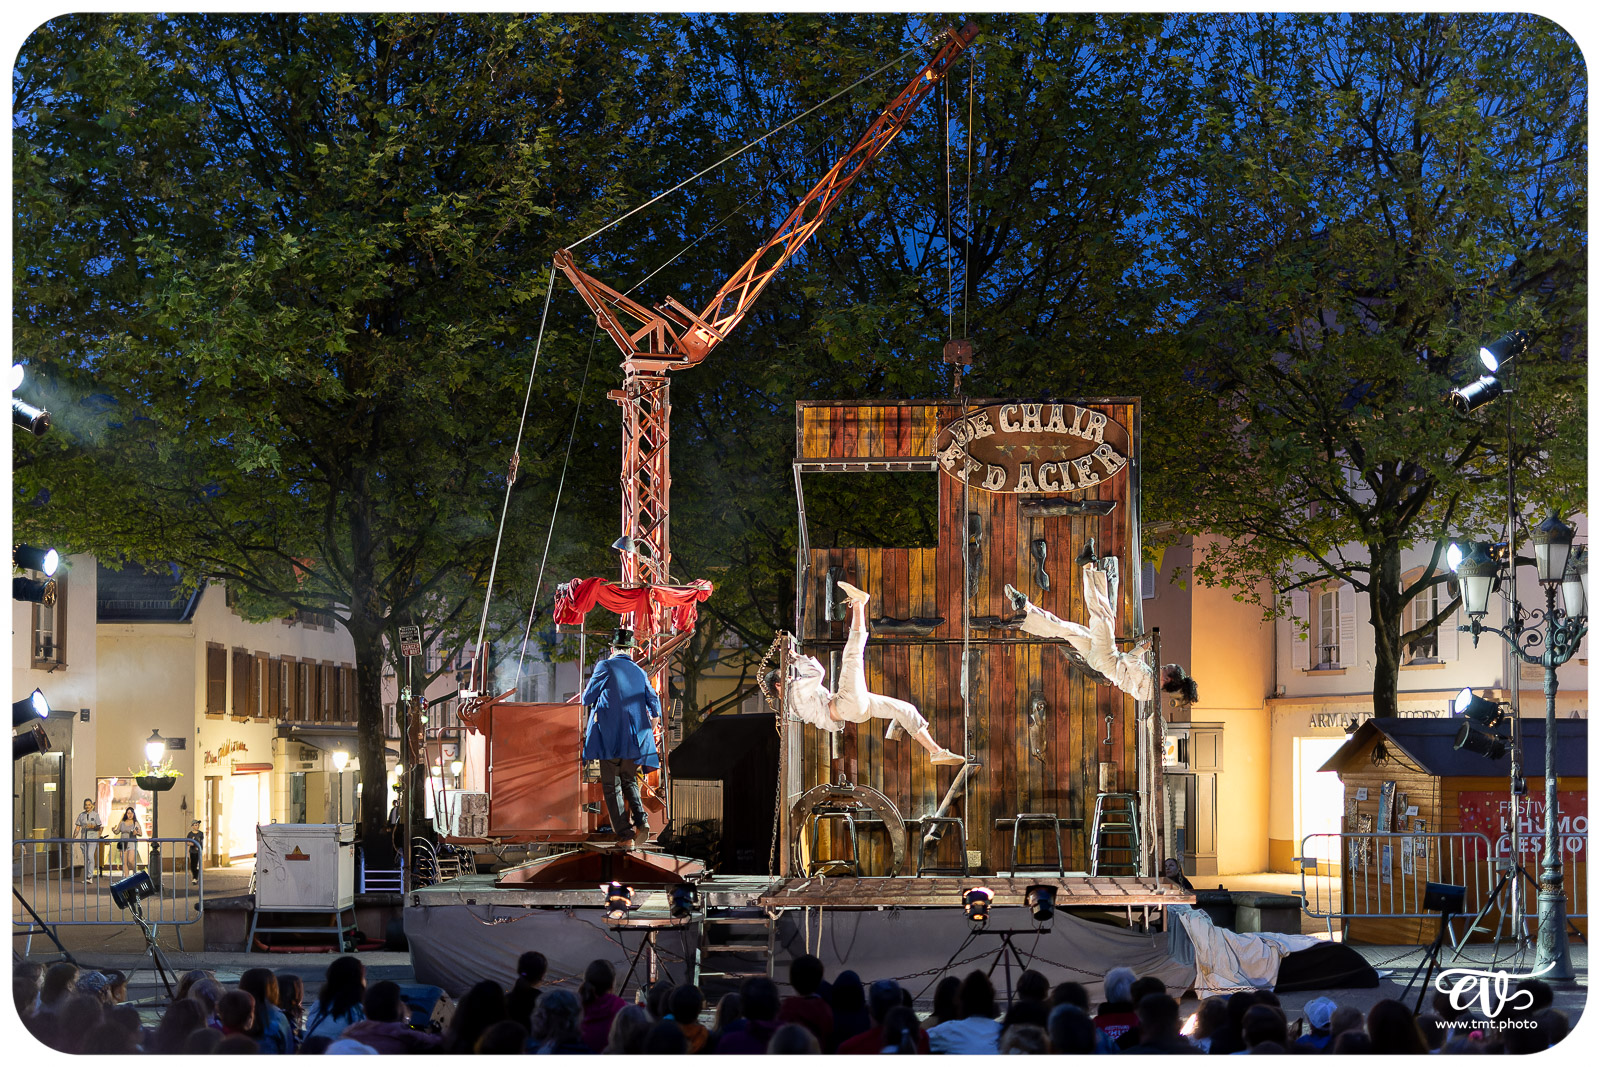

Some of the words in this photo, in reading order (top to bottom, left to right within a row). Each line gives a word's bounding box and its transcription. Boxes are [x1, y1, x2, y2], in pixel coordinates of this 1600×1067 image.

[948, 411, 996, 447] DE
[999, 403, 1108, 444] CHAIR
[937, 439, 983, 481] ET
[982, 464, 1007, 490] D
[1014, 443, 1127, 492] ACIER
[1500, 801, 1565, 814] FSTIVL
